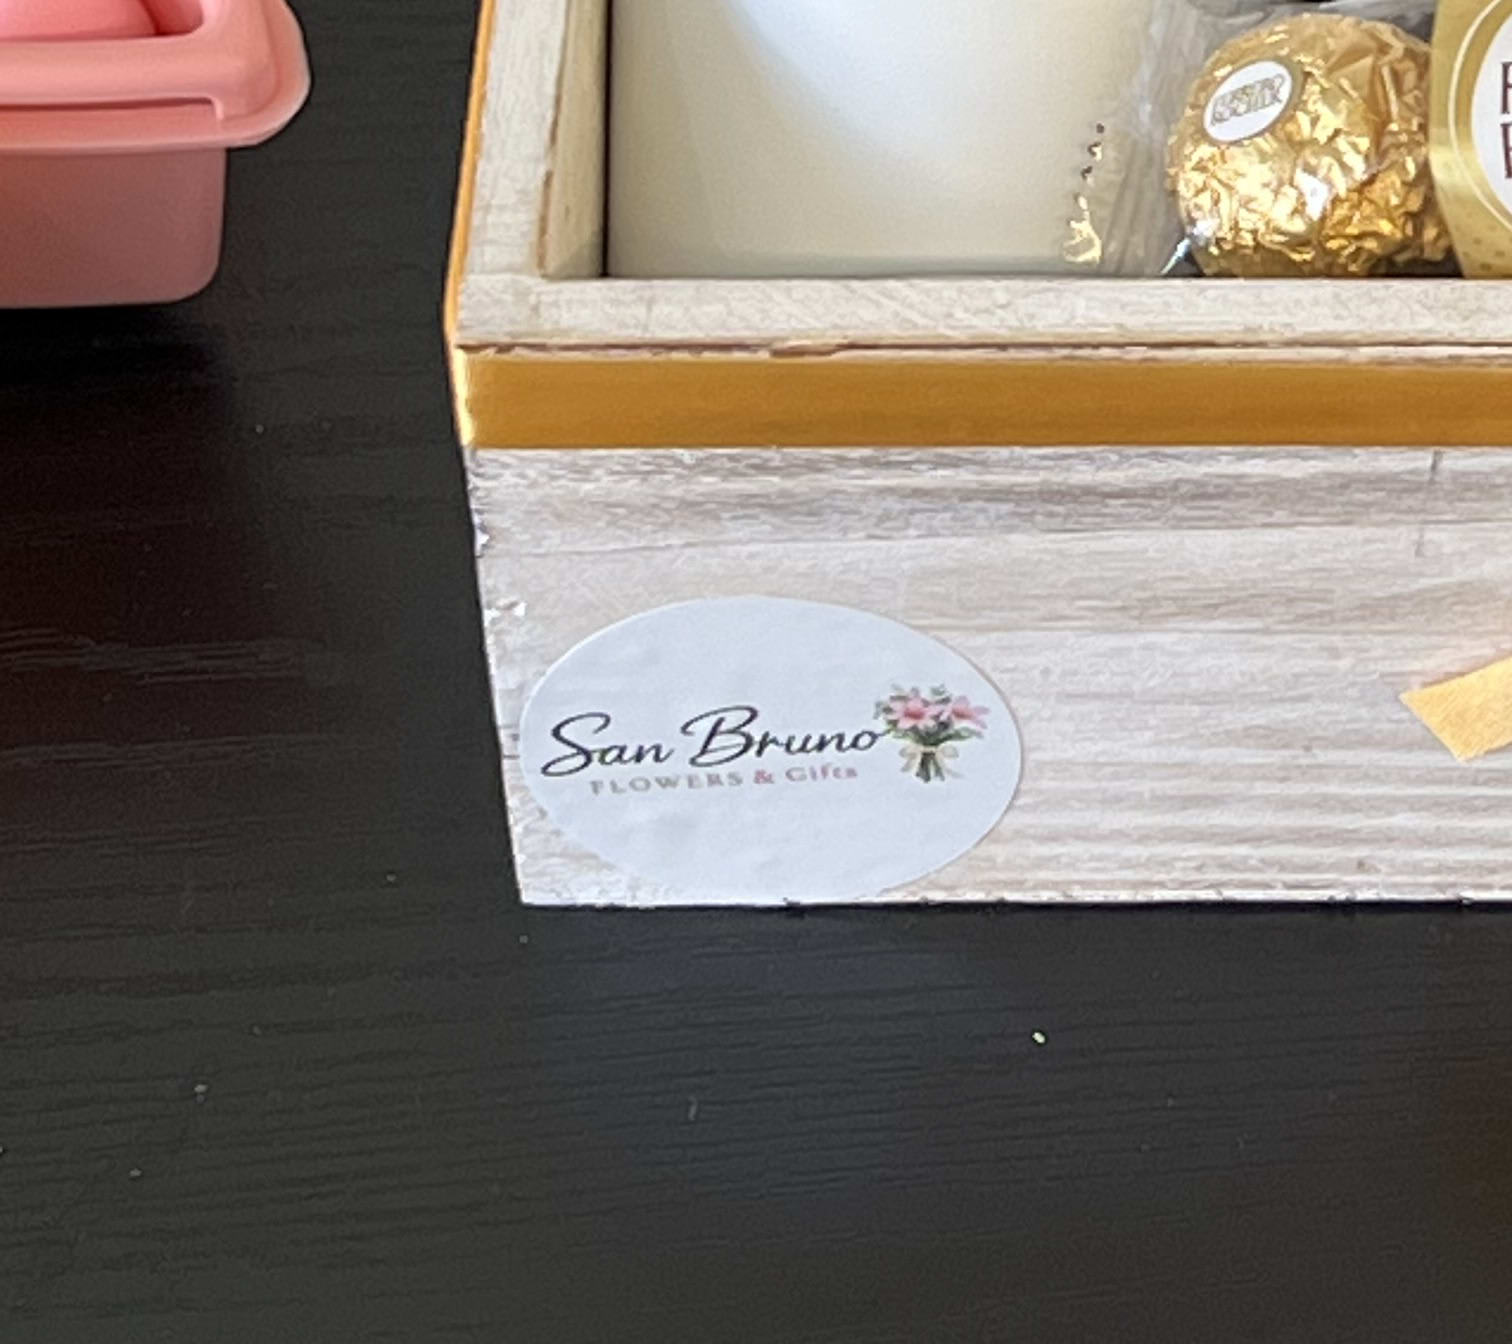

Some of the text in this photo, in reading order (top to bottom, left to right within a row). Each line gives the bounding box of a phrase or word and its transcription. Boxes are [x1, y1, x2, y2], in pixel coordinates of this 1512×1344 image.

[541, 705, 886, 777] San Bruno
[590, 764, 858, 795] FLOWERS & Gifts
